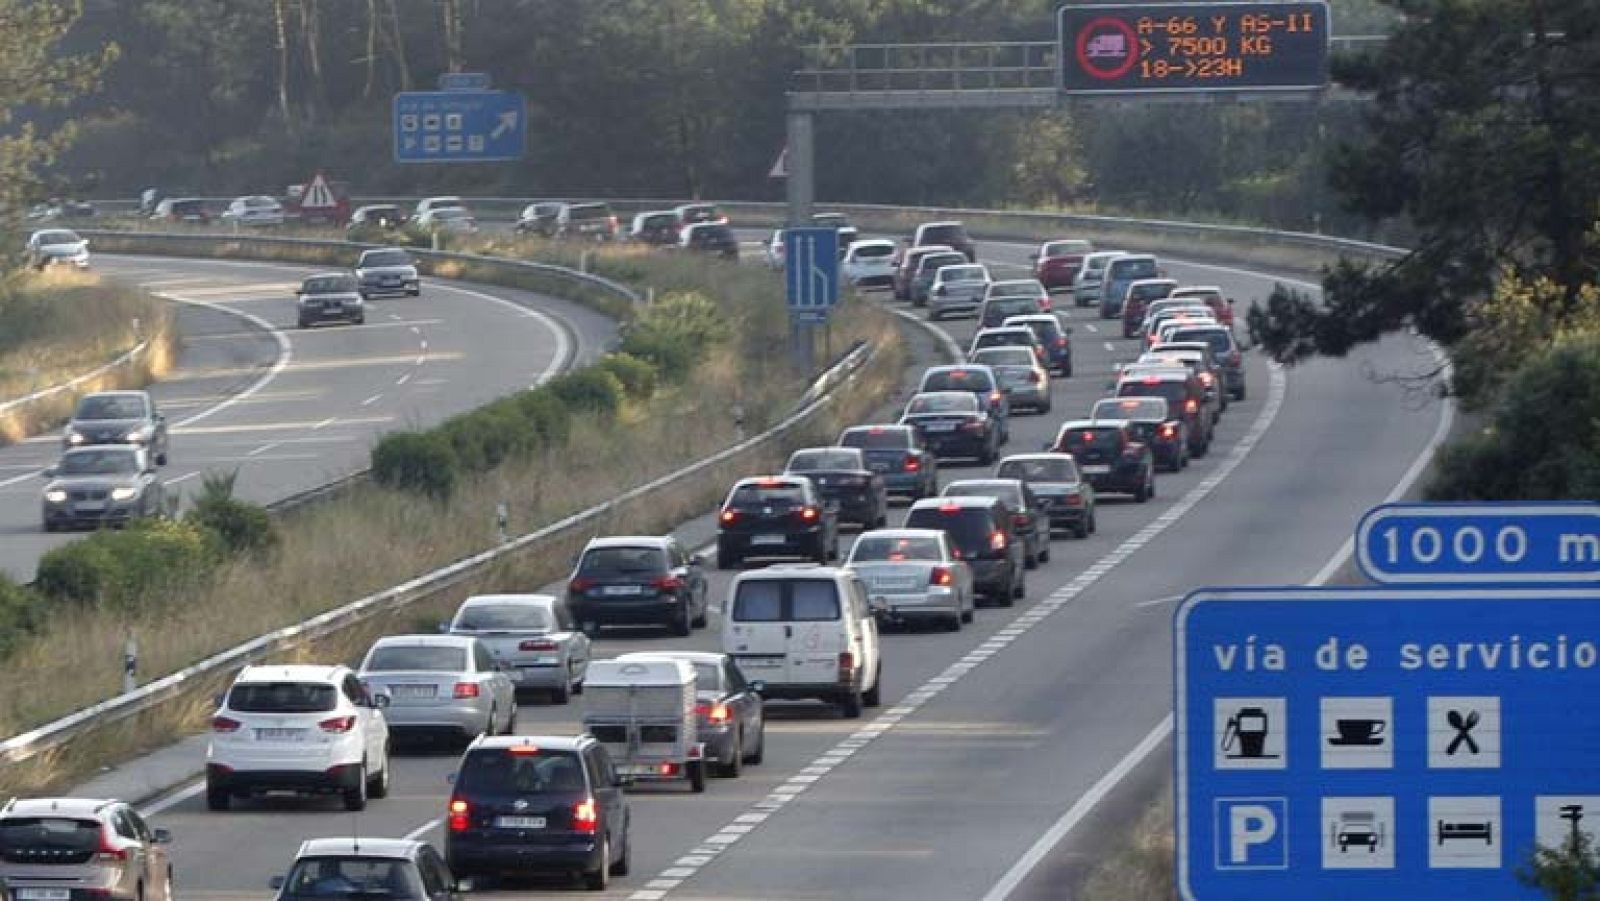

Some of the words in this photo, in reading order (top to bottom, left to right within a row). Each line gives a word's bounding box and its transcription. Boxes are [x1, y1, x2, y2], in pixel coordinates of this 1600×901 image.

[1137, 16, 1198, 34] A-66
[1212, 16, 1226, 32] Y
[1168, 36, 1227, 56] 7500
[1240, 35, 1272, 55] KG
[1382, 525, 1528, 564] 1000
[1558, 533, 1600, 562] m
[1213, 634, 1287, 672] vía
[1315, 636, 1370, 670] de
[1399, 634, 1597, 670] servicio
[1230, 805, 1277, 863] P
